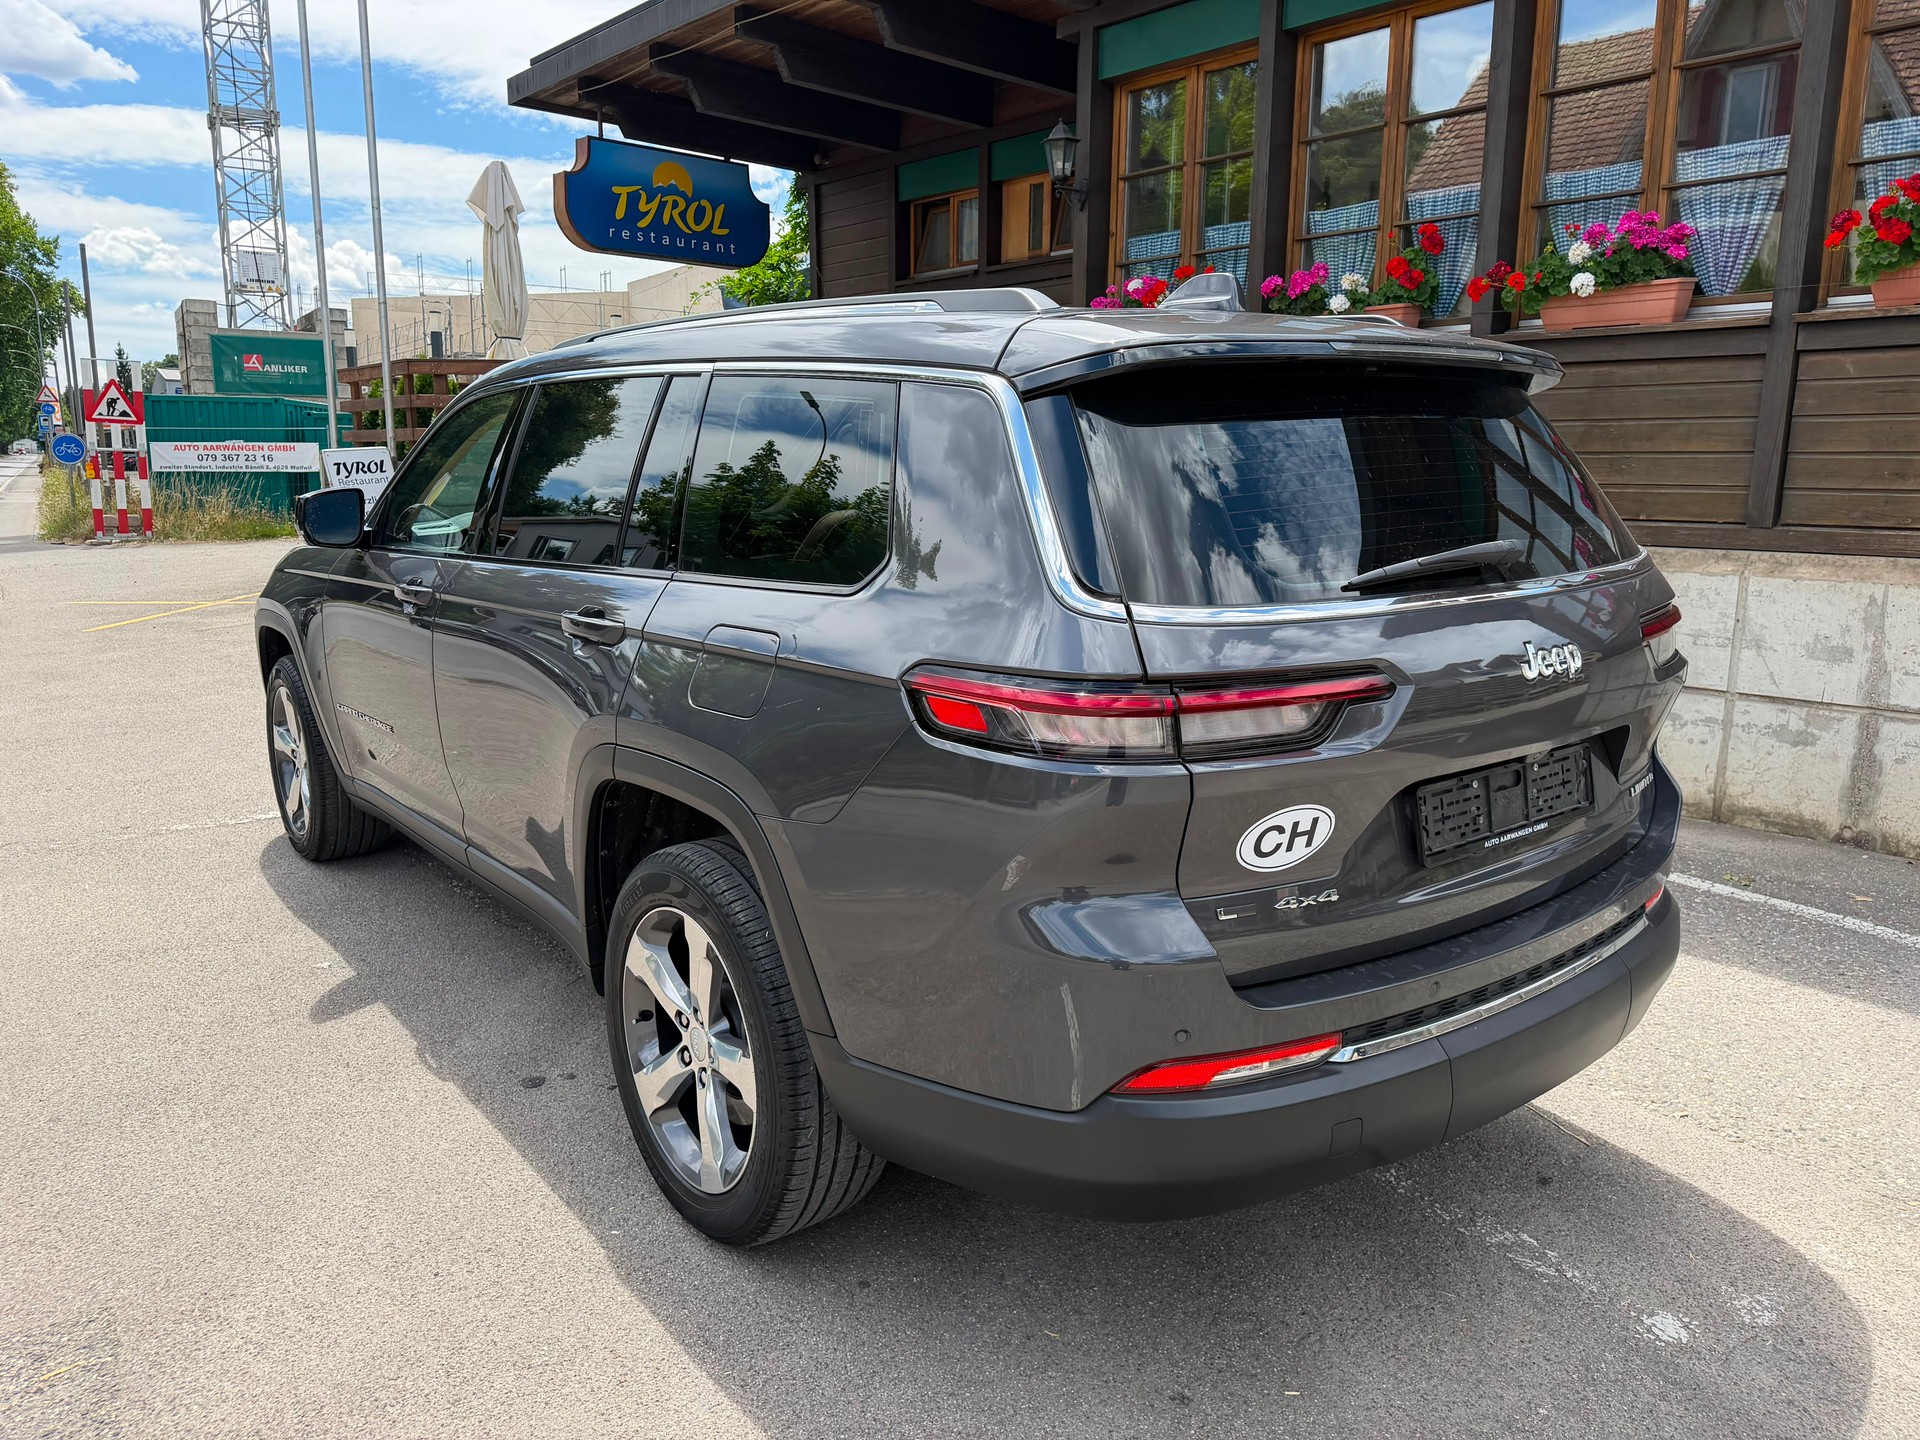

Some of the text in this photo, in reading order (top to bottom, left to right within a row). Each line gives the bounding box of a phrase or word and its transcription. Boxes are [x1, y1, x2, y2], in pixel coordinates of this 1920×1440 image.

[611, 185, 730, 236] TYROL
[609, 227, 736, 255] restaurant
[263, 364, 308, 373] ANLIKER
[174, 444, 296, 452] AUTO AARWANGEN GMBH
[197, 453, 274, 462] 079 367 23 16
[333, 459, 387, 479] TYROL
[337, 476, 390, 486] Restaurant
[1520, 640, 1582, 681] Jeep
[1253, 816, 1320, 858] CH
[1484, 821, 1549, 848] AUTO AARWANGEN GMBH
[1274, 888, 1339, 909] 4x4
